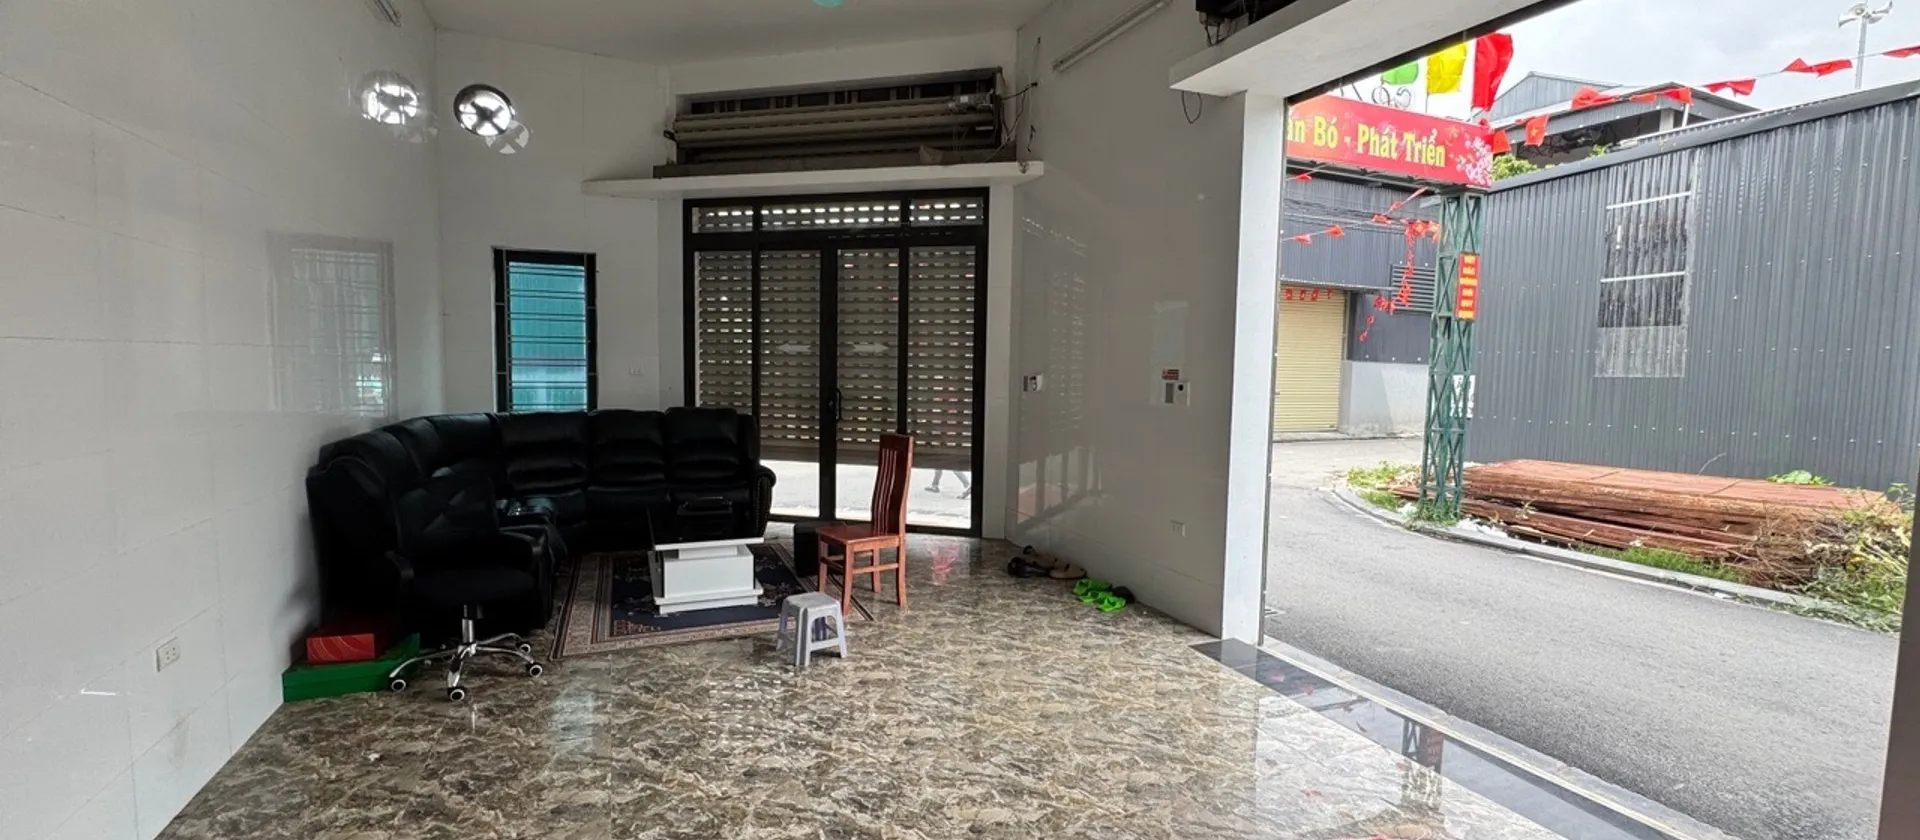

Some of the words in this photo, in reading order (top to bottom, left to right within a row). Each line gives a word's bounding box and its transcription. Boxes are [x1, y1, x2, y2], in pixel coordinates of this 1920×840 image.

[1313, 115, 1339, 149] Bó
[1357, 123, 1399, 160] Phát
[1403, 128, 1446, 168] Triển
